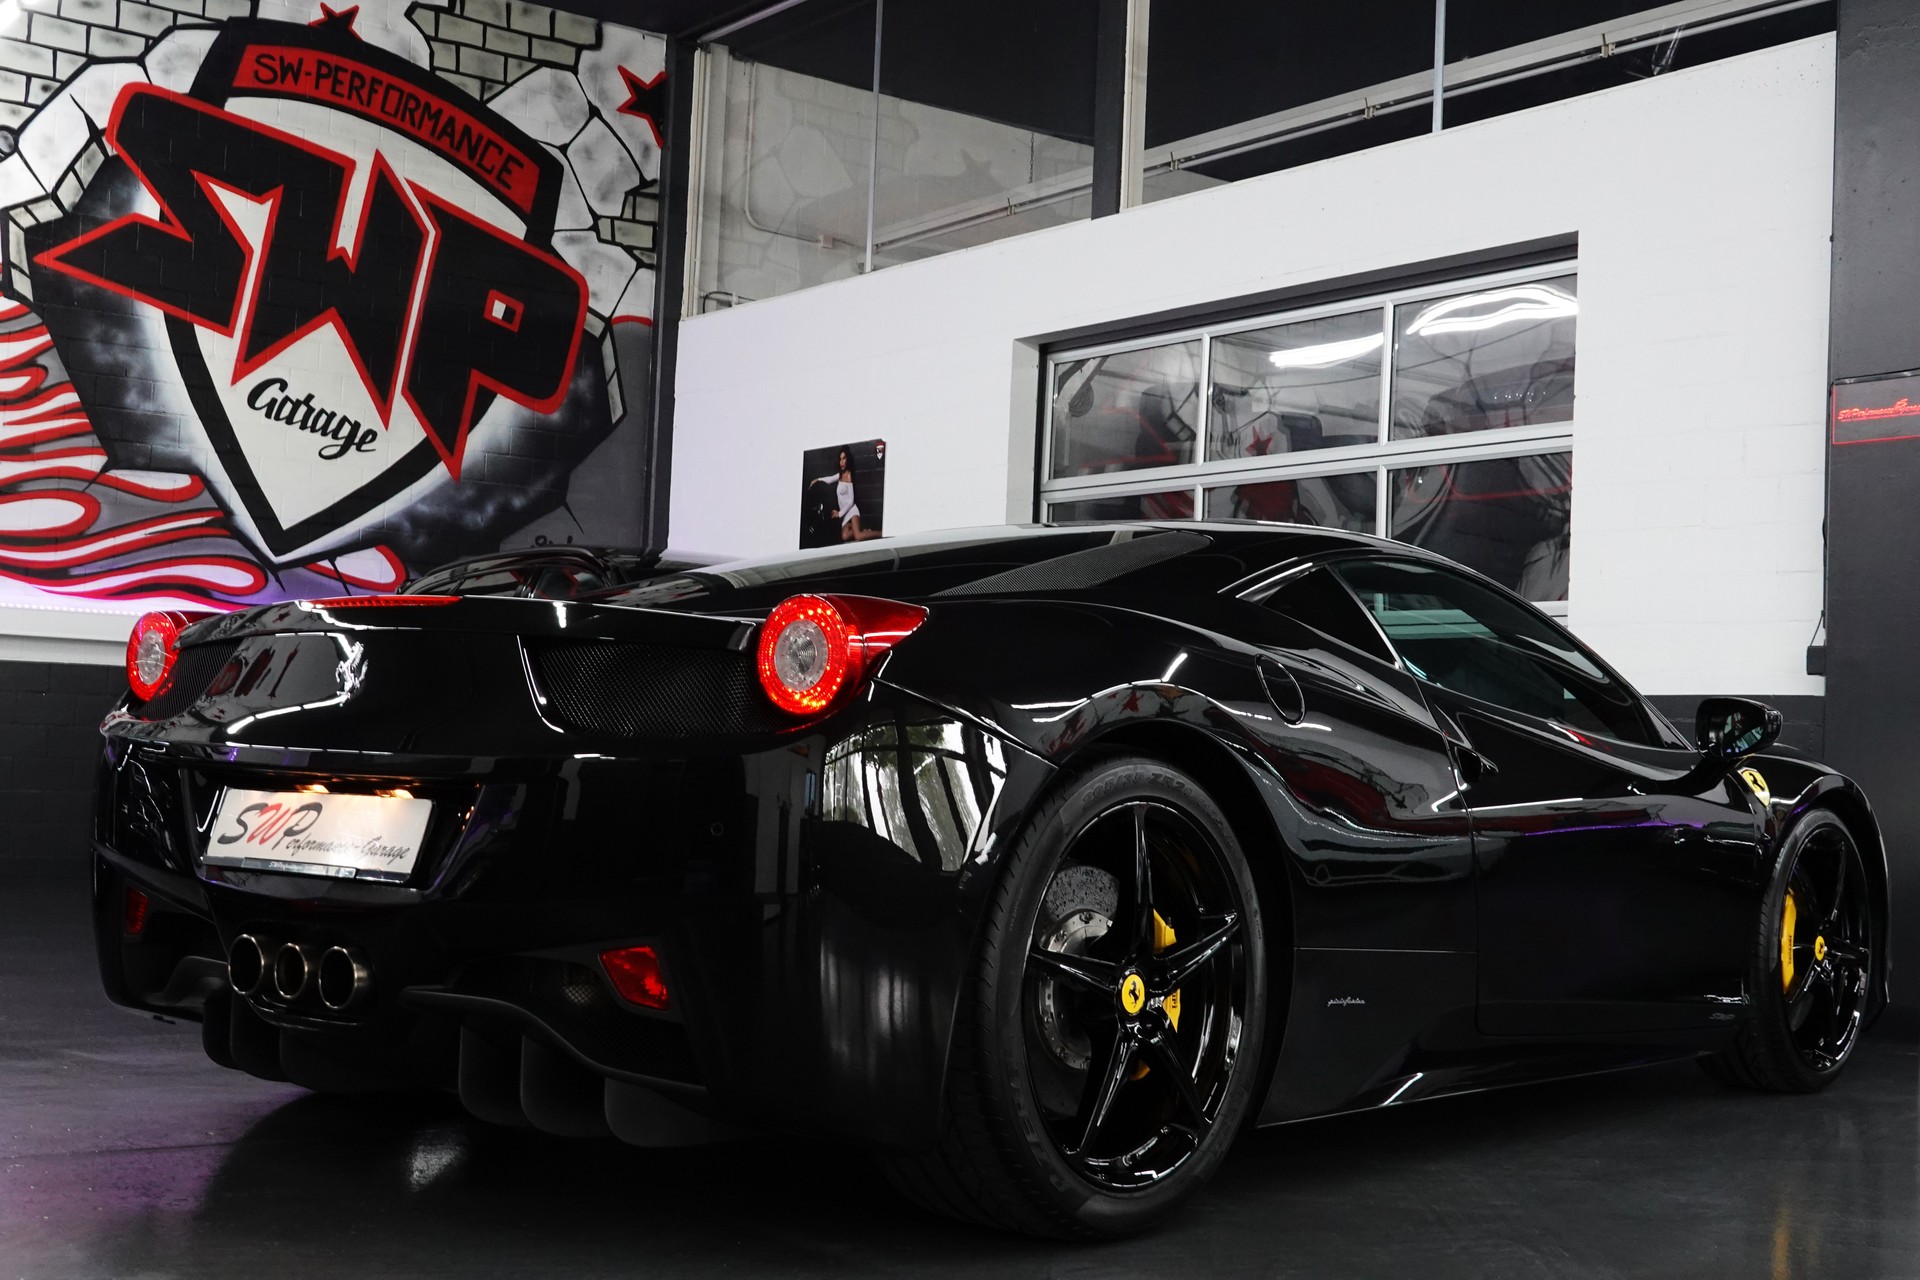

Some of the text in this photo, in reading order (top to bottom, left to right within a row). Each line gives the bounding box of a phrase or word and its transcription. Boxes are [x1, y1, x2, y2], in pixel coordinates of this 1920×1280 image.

[253, 53, 525, 190] SW-PERFORMANCE
[33, 81, 590, 483] SWP
[246, 377, 378, 460] Garage
